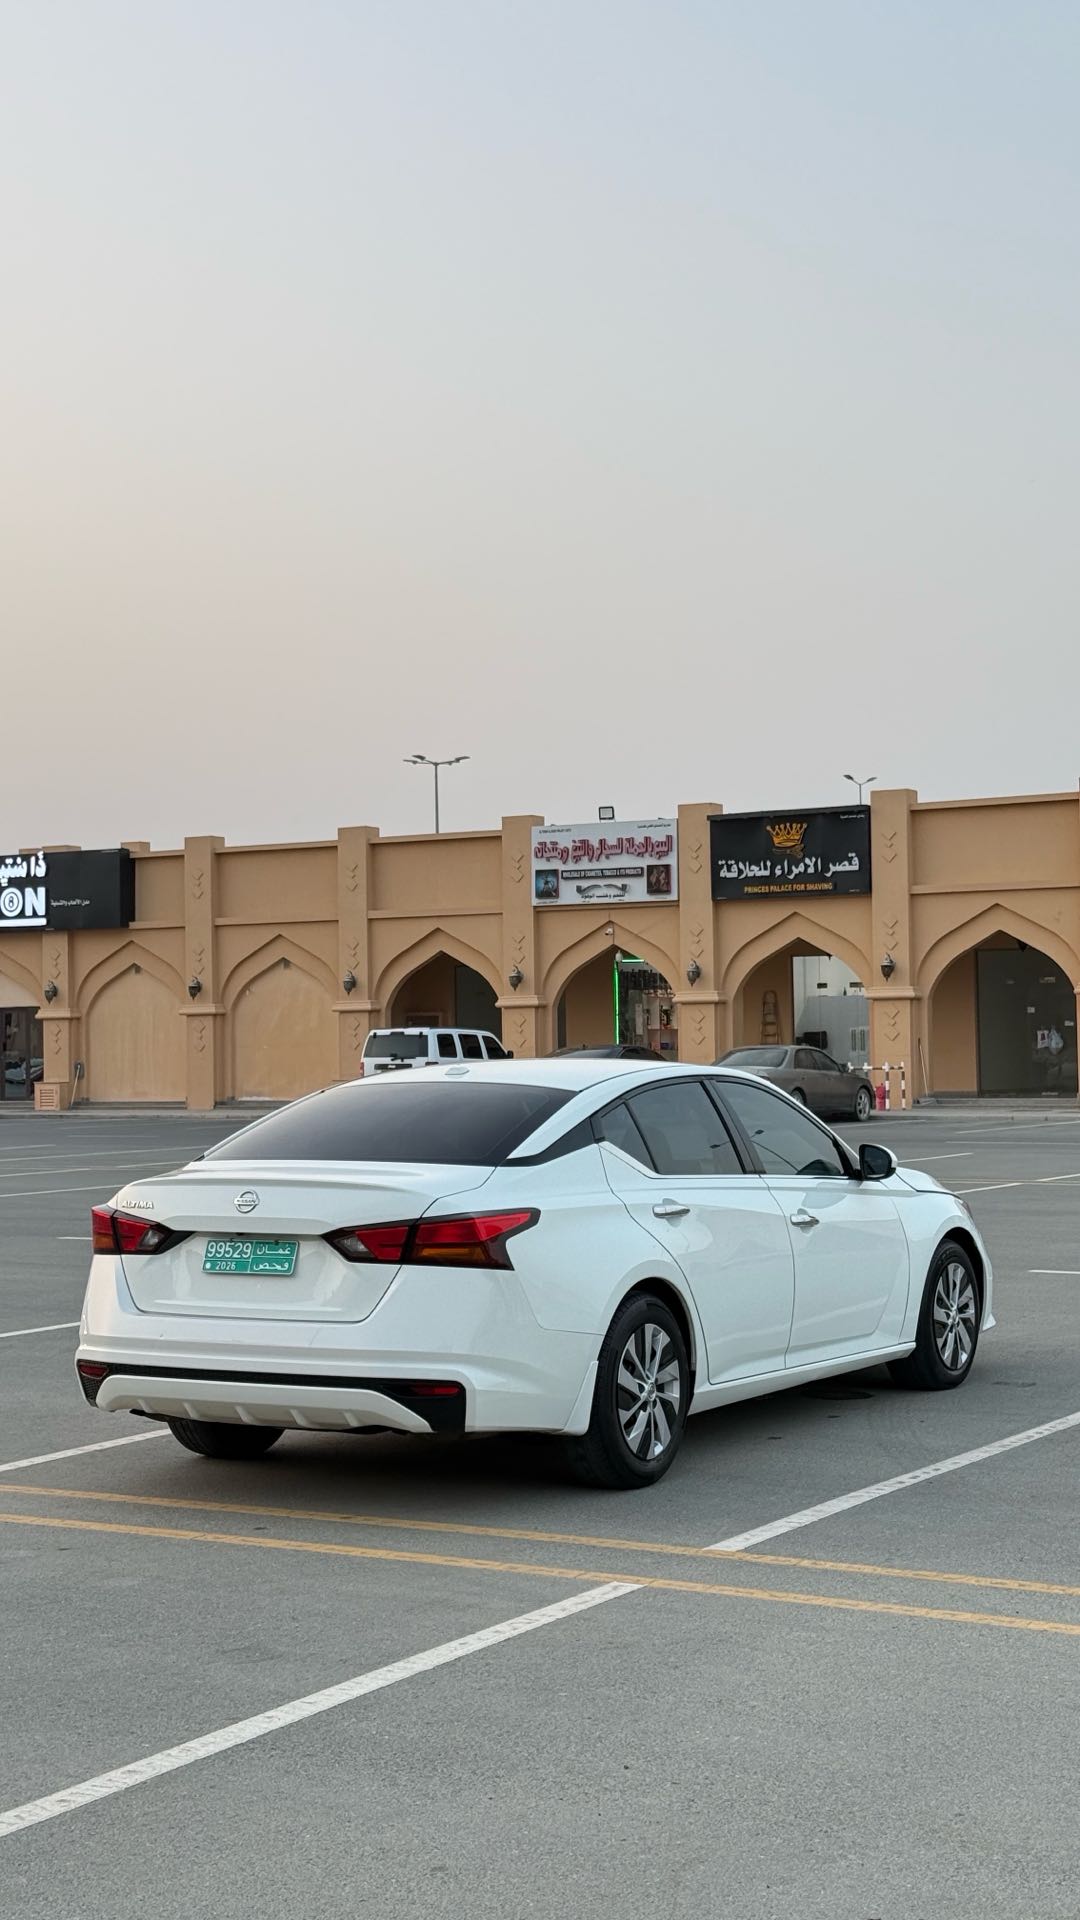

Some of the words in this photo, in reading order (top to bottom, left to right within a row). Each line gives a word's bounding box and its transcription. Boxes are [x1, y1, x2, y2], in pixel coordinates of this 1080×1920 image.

[718, 859, 771, 879] للحلاقة
[775, 856, 821, 879] الامراء
[824, 852, 860, 877] قصر
[770, 884, 793, 893] PALACE
[793, 883, 805, 891] FOR
[806, 882, 833, 891] SHAVING
[122, 1200, 154, 1209] ALTIMA
[207, 1242, 252, 1258] 99529
[215, 1261, 236, 1270] 2026
[253, 1260, 289, 1271] فحص
